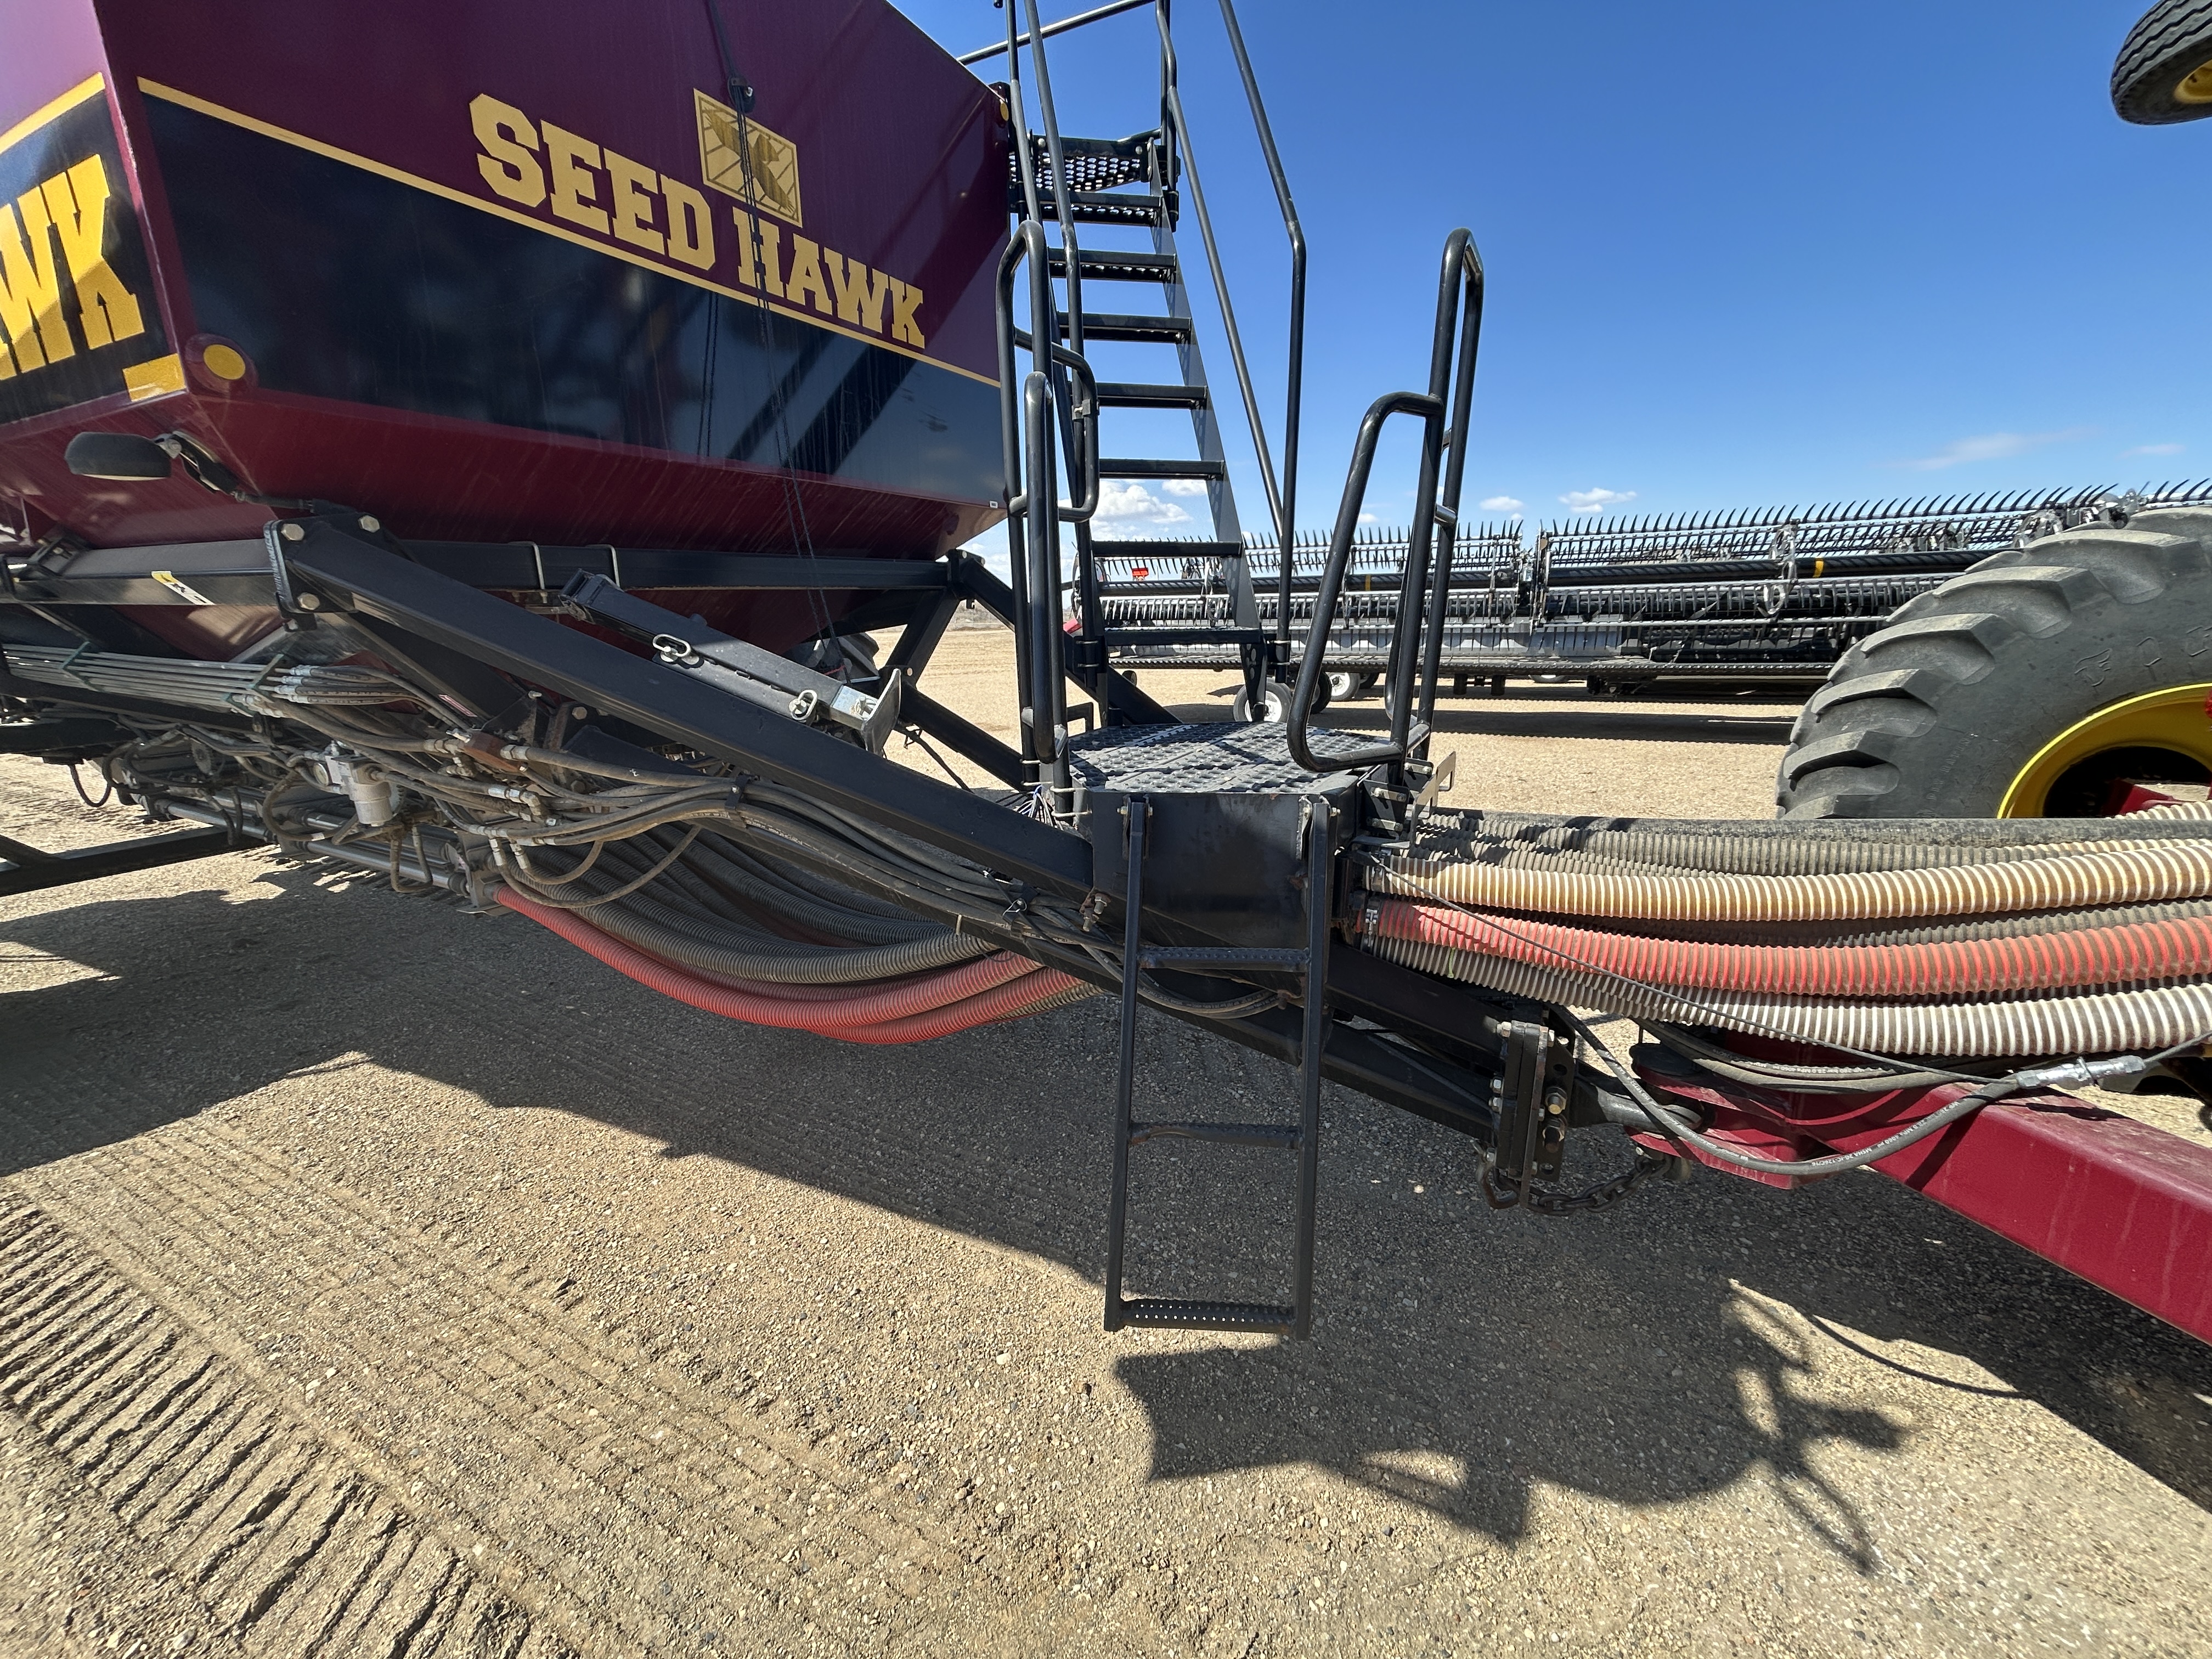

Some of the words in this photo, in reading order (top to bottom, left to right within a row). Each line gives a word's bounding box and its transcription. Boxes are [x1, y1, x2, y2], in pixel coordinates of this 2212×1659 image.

[0, 154, 145, 381] WK
[469, 93, 715, 271] SEED
[733, 206, 926, 349] HAWK
